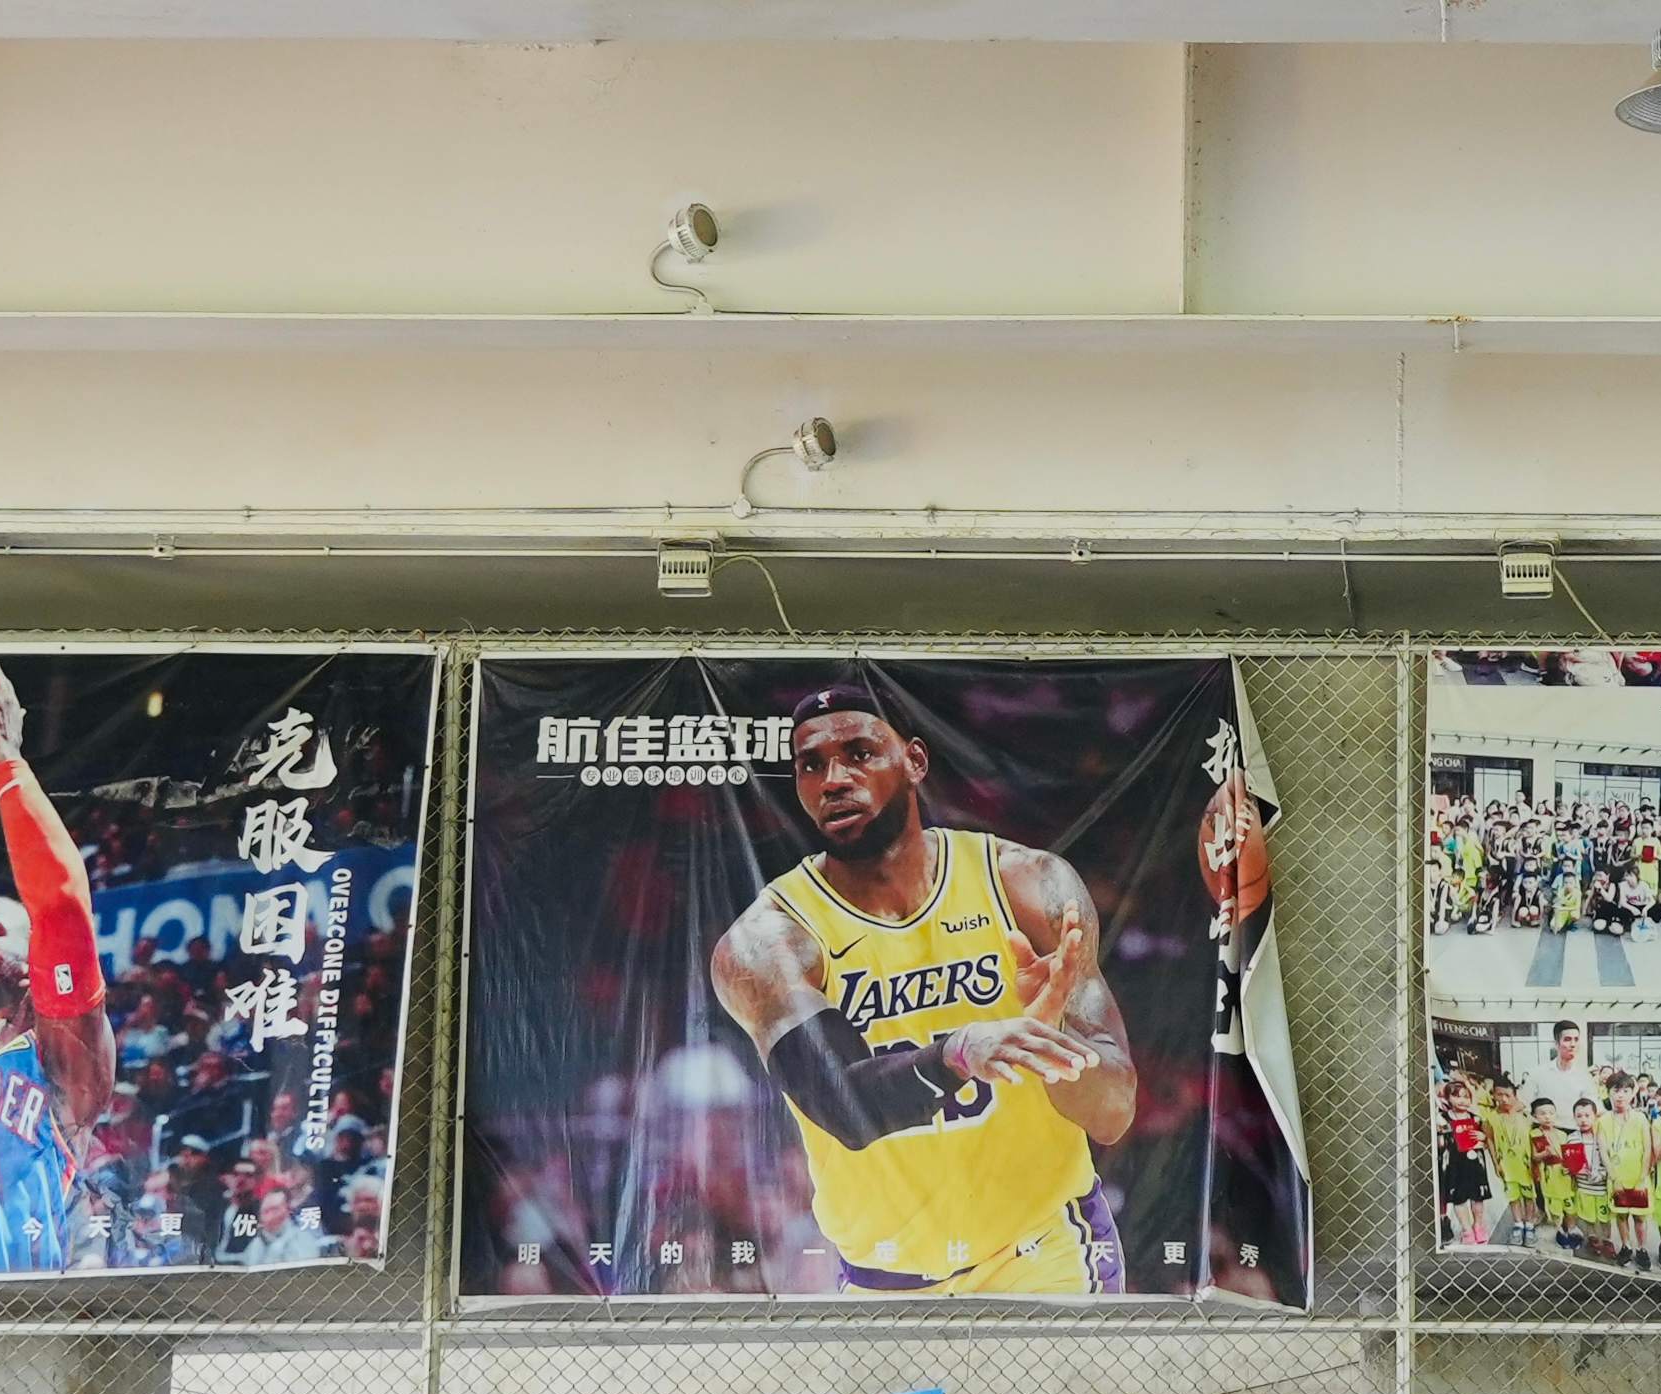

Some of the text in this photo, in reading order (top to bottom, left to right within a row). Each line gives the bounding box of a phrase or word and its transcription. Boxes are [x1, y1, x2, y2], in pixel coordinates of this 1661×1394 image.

[536, 717, 794, 764] 航佳篮球
[580, 765, 748, 786] 专业篮球培训中心
[224, 706, 338, 1054] 克服困难
[940, 914, 990, 934] wish
[303, 867, 352, 1151] OVERCONE DIFFICULTIES
[839, 953, 1004, 1031] LAKERS
